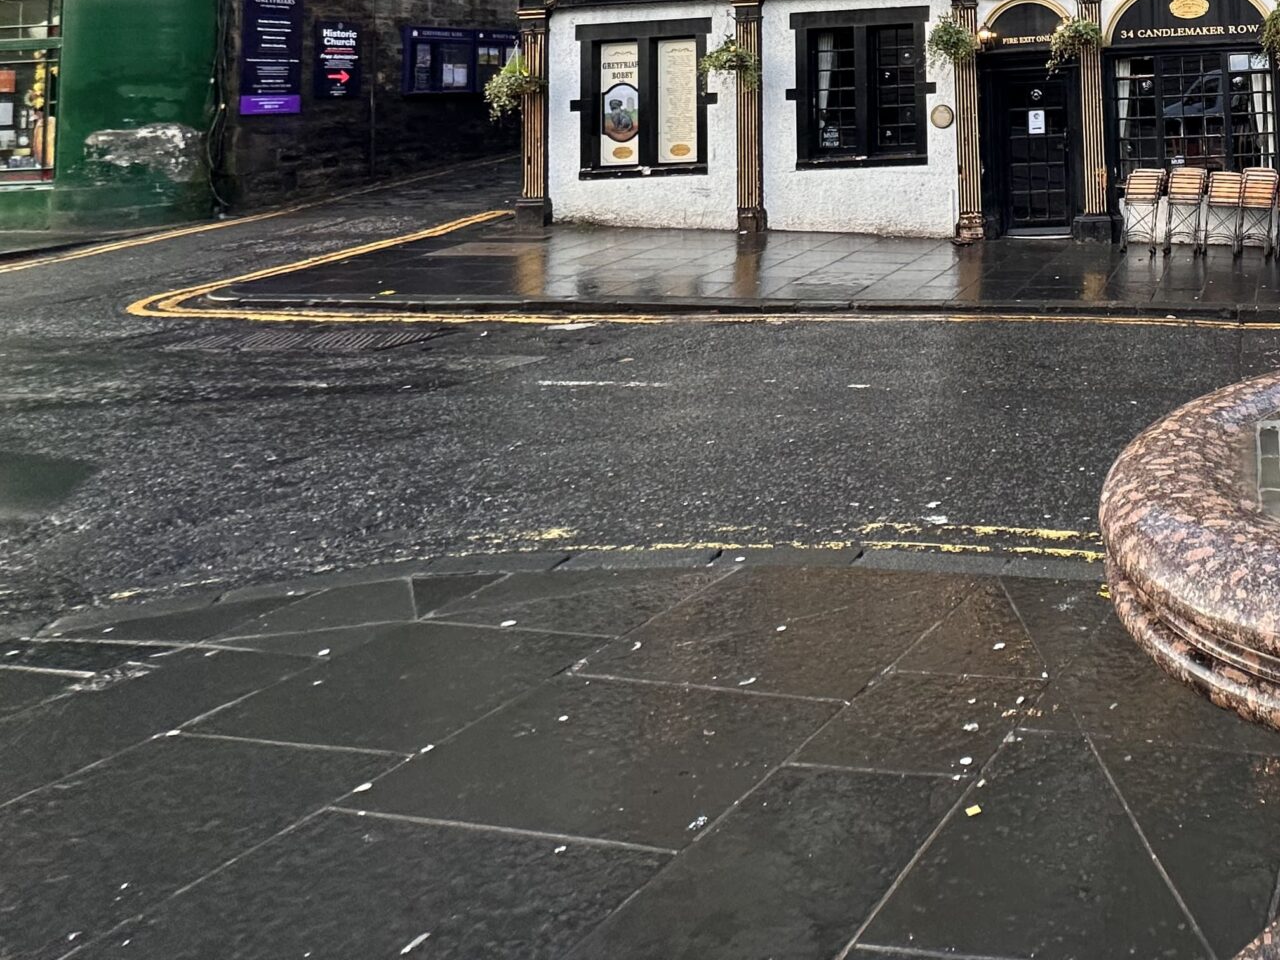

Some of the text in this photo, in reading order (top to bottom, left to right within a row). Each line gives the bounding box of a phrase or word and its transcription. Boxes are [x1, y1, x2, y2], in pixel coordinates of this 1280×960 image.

[322, 28, 358, 39] Historic
[1120, 24, 1259, 38] 34 CANDLEMAKER ROW
[324, 37, 356, 47] Church
[1002, 37, 1018, 45] FIRE
[1019, 36, 1035, 44] EXIT
[611, 71, 634, 80] BOBBY
